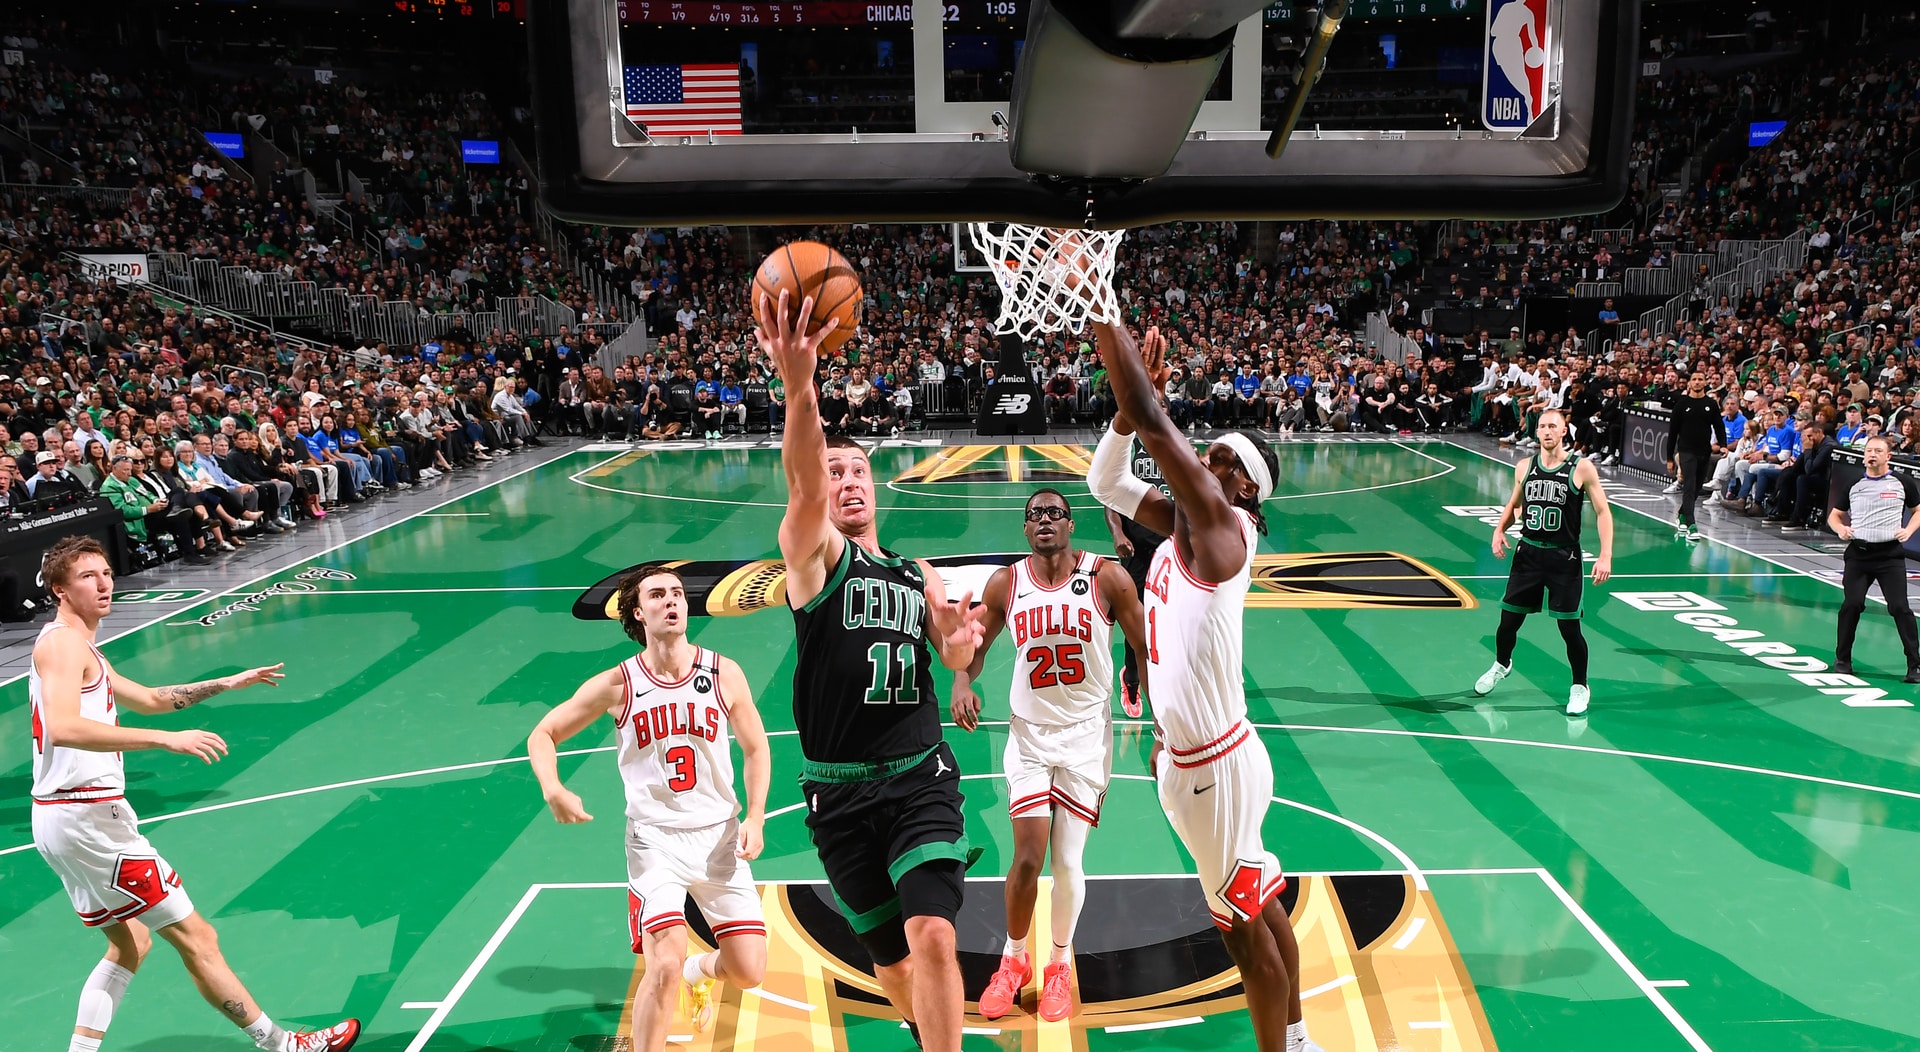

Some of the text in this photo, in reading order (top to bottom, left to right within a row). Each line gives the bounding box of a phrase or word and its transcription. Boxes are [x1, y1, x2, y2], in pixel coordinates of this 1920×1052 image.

[620, 10, 802, 23] 0 7 1/9 6/19 31.6 5 5
[866, 5, 915, 22] CHICAG
[986, 2, 1016, 14] 1:05
[1266, 9, 1291, 19] 15/21
[1371, 6, 1377, 15] 6
[1394, 4, 1405, 14] 11
[1420, 4, 1426, 13] 8
[1647, 63, 1658, 74] 19
[1492, 97, 1521, 121] NBA
[998, 374, 1026, 383] Amica
[1524, 480, 1569, 505] CELTICS
[1525, 504, 1562, 532] 30
[842, 577, 926, 640] CELTIC
[1014, 603, 1092, 648] BULLS
[1148, 606, 1160, 665] 1
[863, 642, 920, 705] 11
[1026, 643, 1087, 690] 25
[1673, 611, 1916, 707] GARDEN
[31, 699, 44, 755] 4
[632, 702, 719, 750] BULLS
[665, 745, 698, 793] 3
